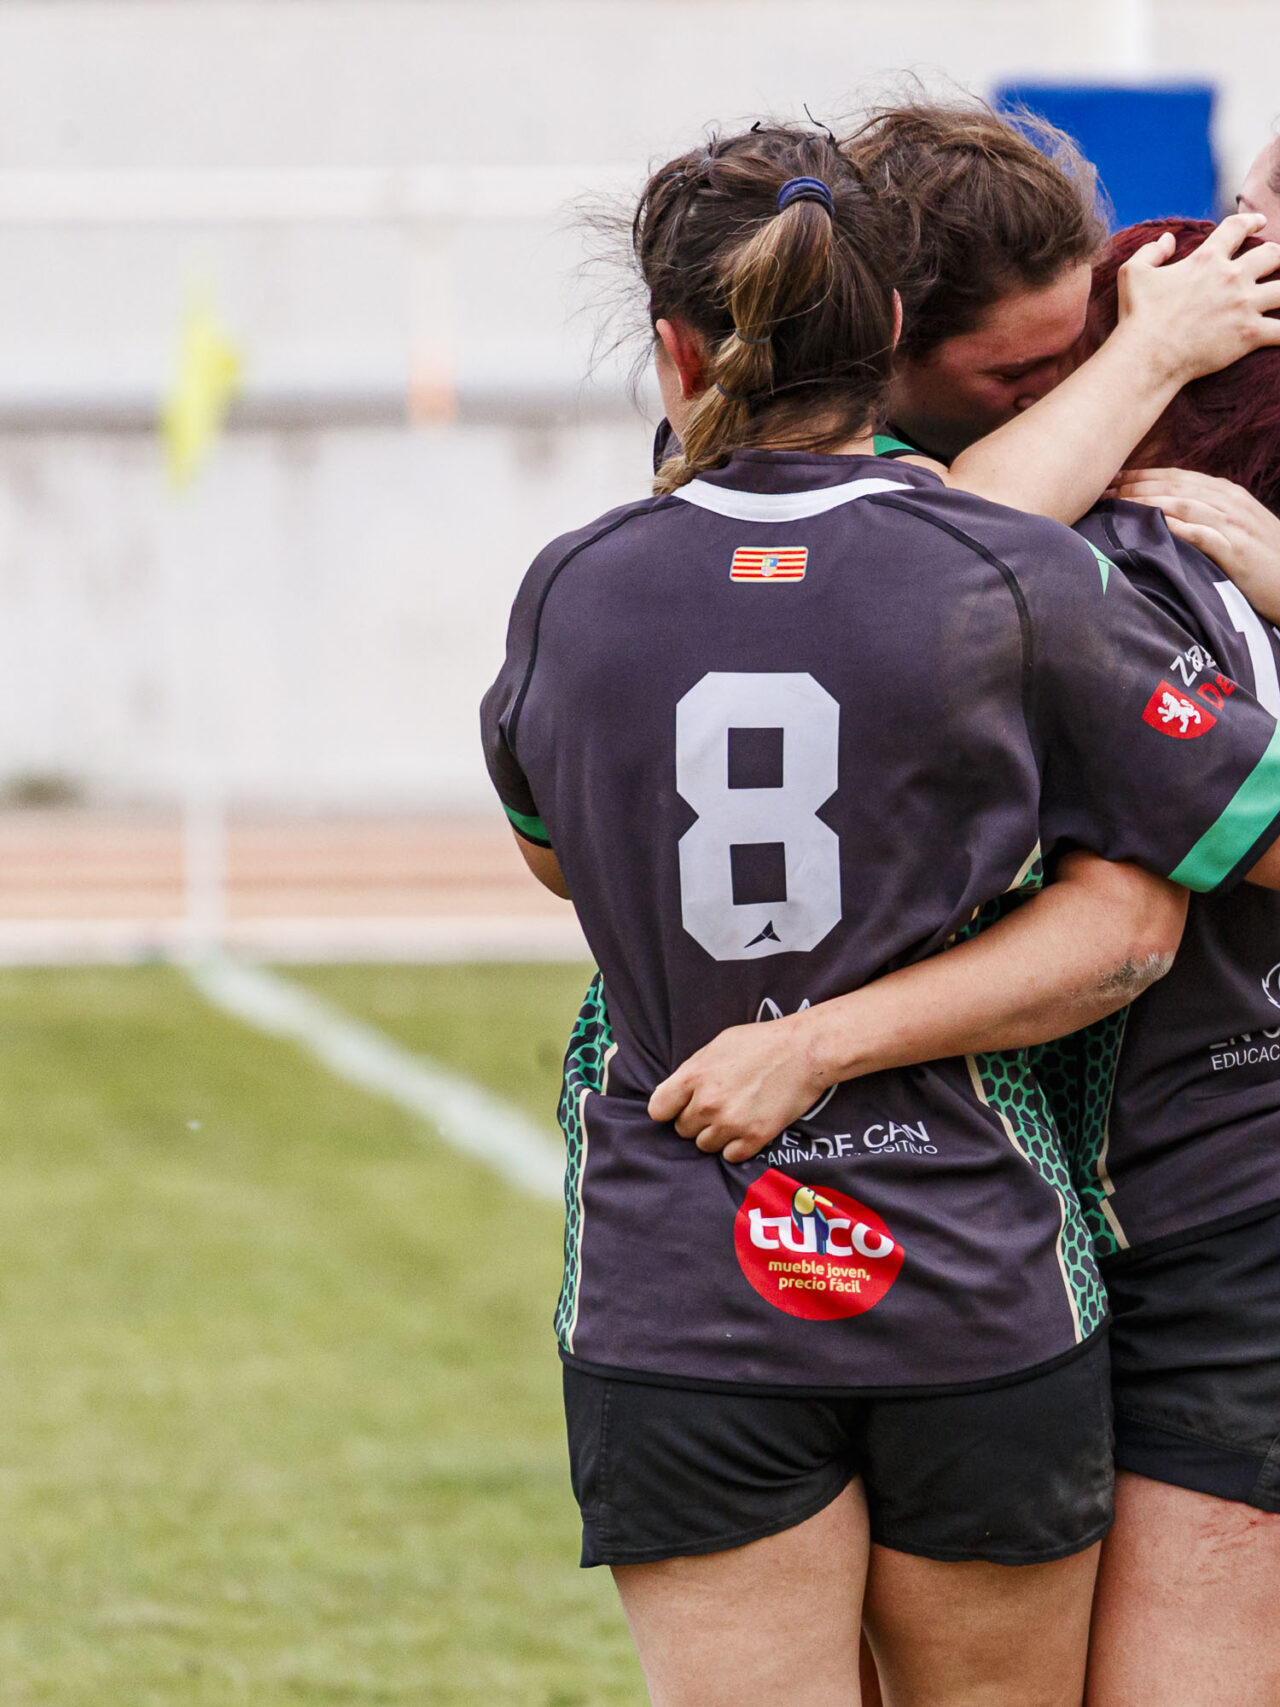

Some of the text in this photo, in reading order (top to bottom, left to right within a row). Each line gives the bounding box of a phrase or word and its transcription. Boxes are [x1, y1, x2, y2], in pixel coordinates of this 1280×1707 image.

[676, 672, 842, 961] 8
[863, 1121, 930, 1149] CAN
[748, 1206, 895, 1259] tuco
[768, 1259, 871, 1282] mueble joven,
[778, 1275, 862, 1294] precio fácil
